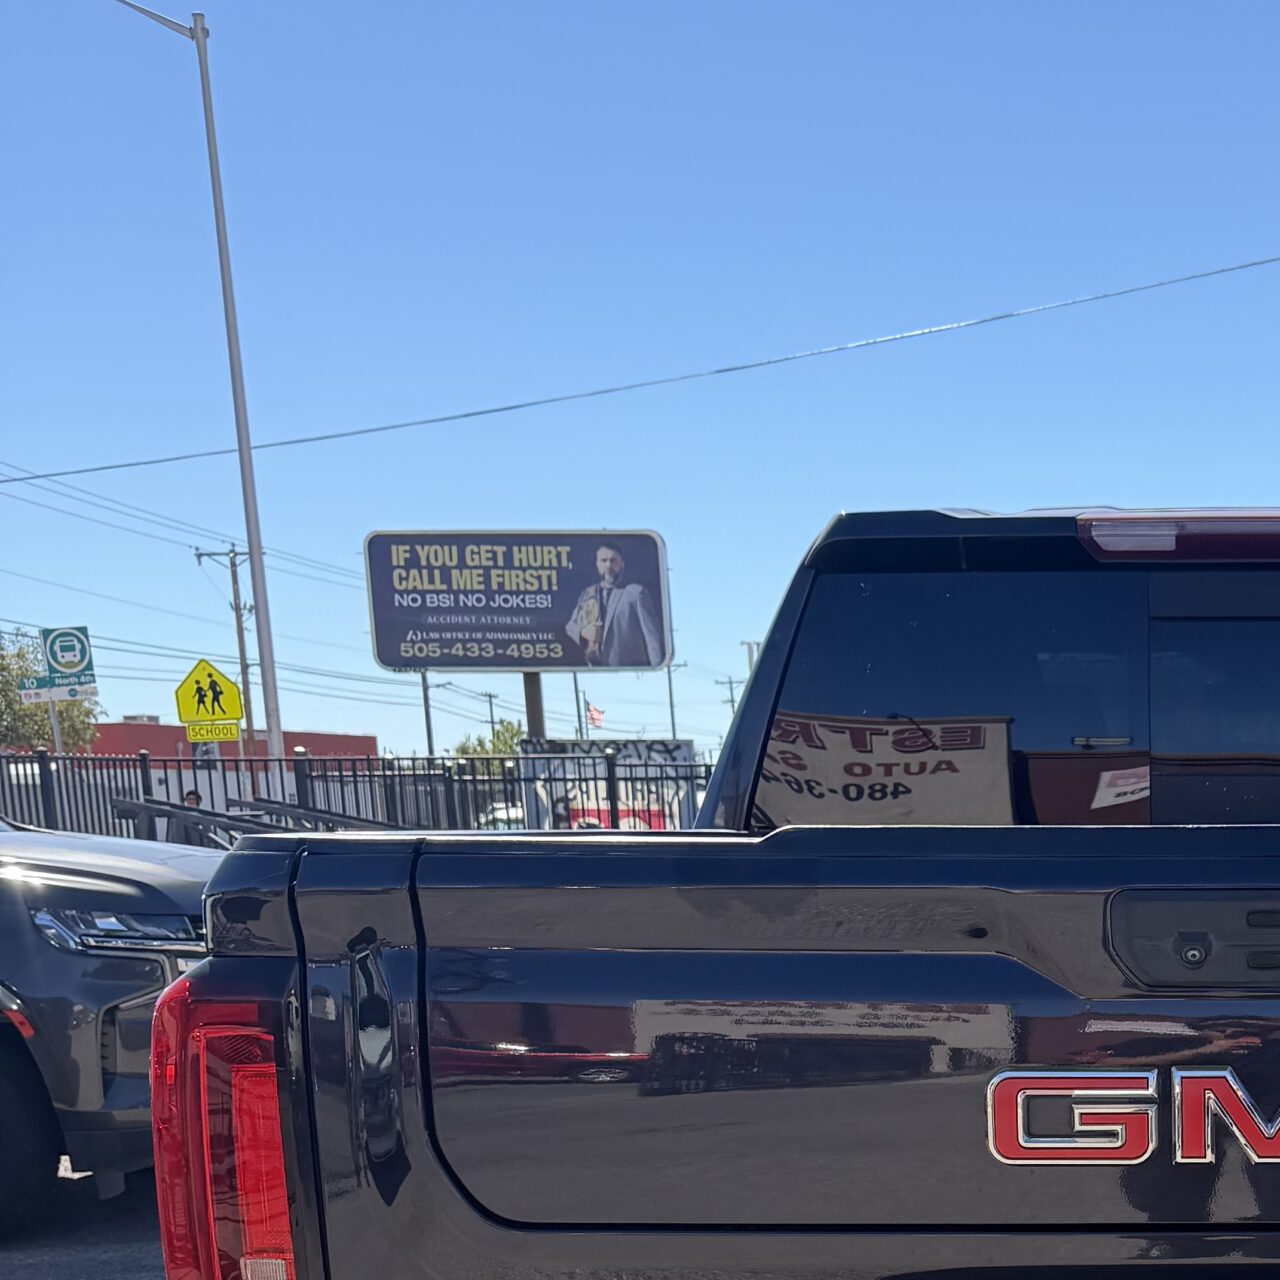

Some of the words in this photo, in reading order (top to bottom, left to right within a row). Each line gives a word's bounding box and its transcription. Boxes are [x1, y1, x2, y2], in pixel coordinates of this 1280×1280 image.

[390, 544, 411, 567] IF
[414, 544, 459, 567] YOU
[464, 544, 507, 567] GET
[512, 545, 573, 570] HURT,
[392, 568, 448, 591] CALL
[451, 568, 486, 591] ME
[490, 568, 559, 591] FIRST!
[394, 593, 422, 608] NO
[425, 593, 455, 608] BS!
[459, 593, 487, 608] NO
[489, 593, 553, 609] JOKES!
[426, 615, 477, 624] ACCIDENT
[479, 615, 532, 625] ATTORNEY
[399, 642, 564, 659] 505-433-4953
[23, 678, 38, 689] 10
[55, 676, 79, 686] North
[190, 725, 236, 738] SCHOOL
